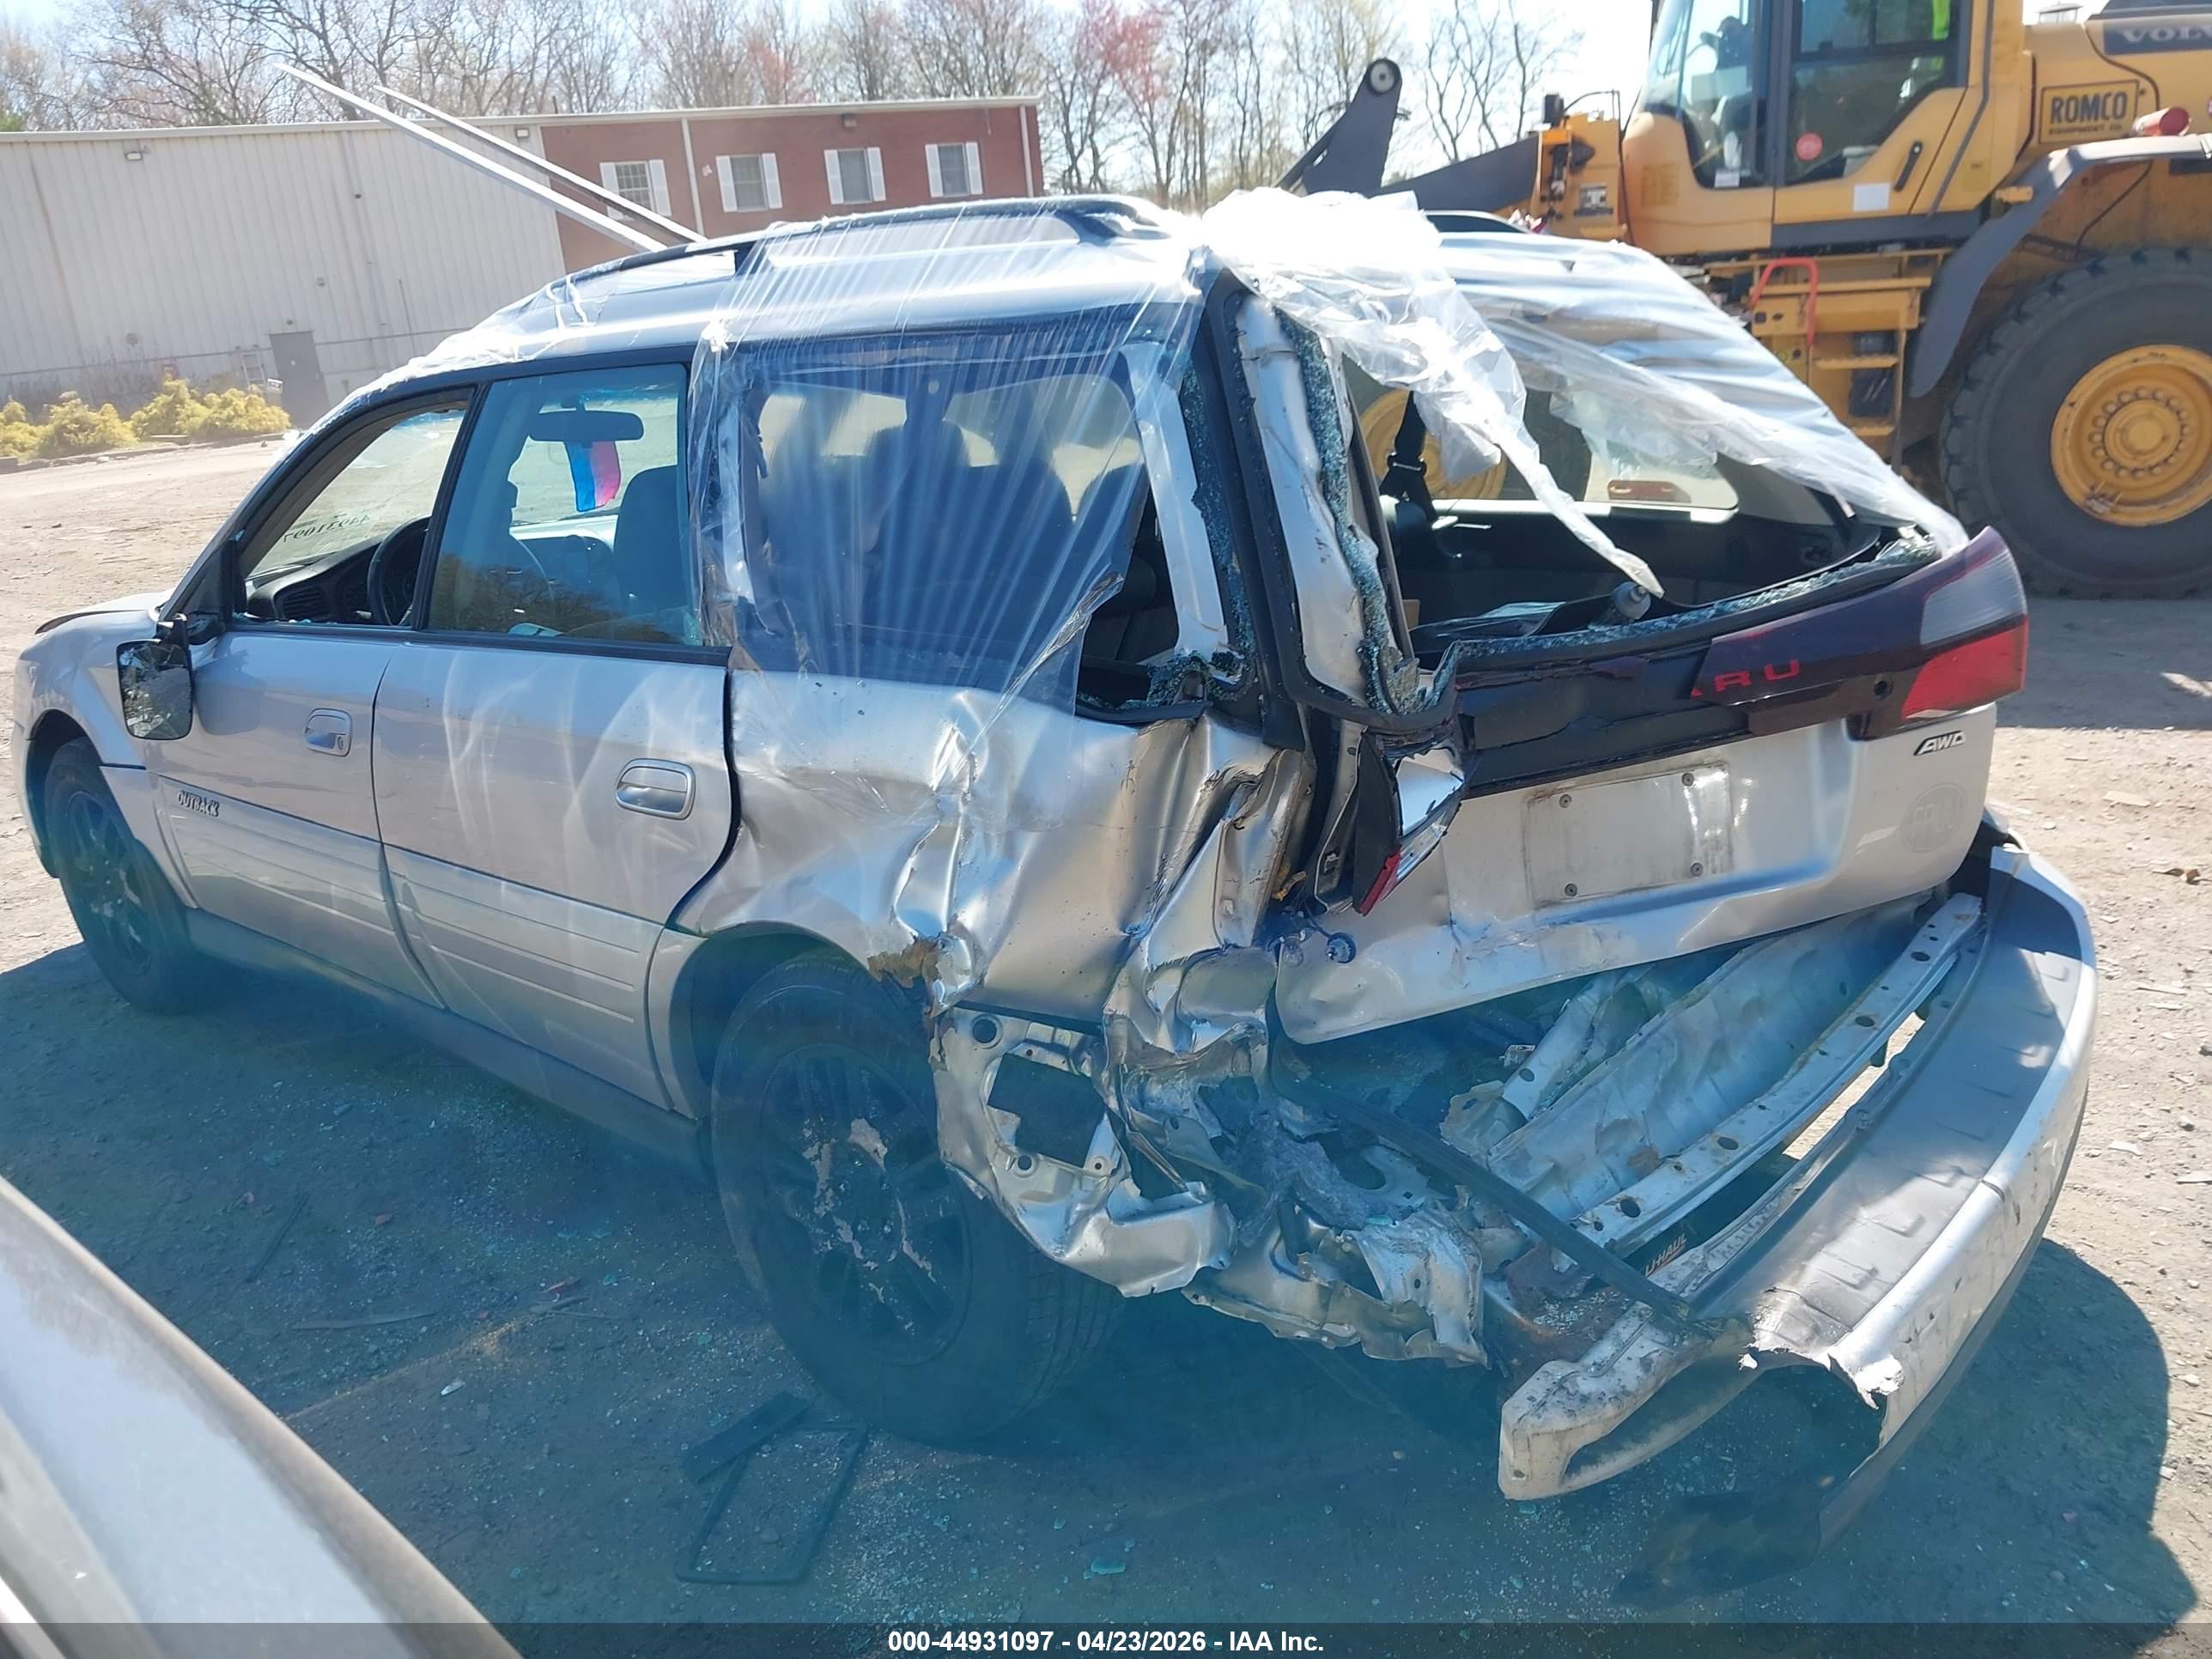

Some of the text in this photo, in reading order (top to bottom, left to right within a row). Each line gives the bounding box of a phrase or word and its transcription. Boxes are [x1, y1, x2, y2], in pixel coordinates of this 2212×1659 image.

[2051, 91, 2128, 125] ROMCO
[1691, 659, 1800, 697] RU
[1914, 730, 1966, 756] AWD
[178, 789, 220, 817] OUTBACK
[1644, 1231, 1687, 1278] U-HAUL
